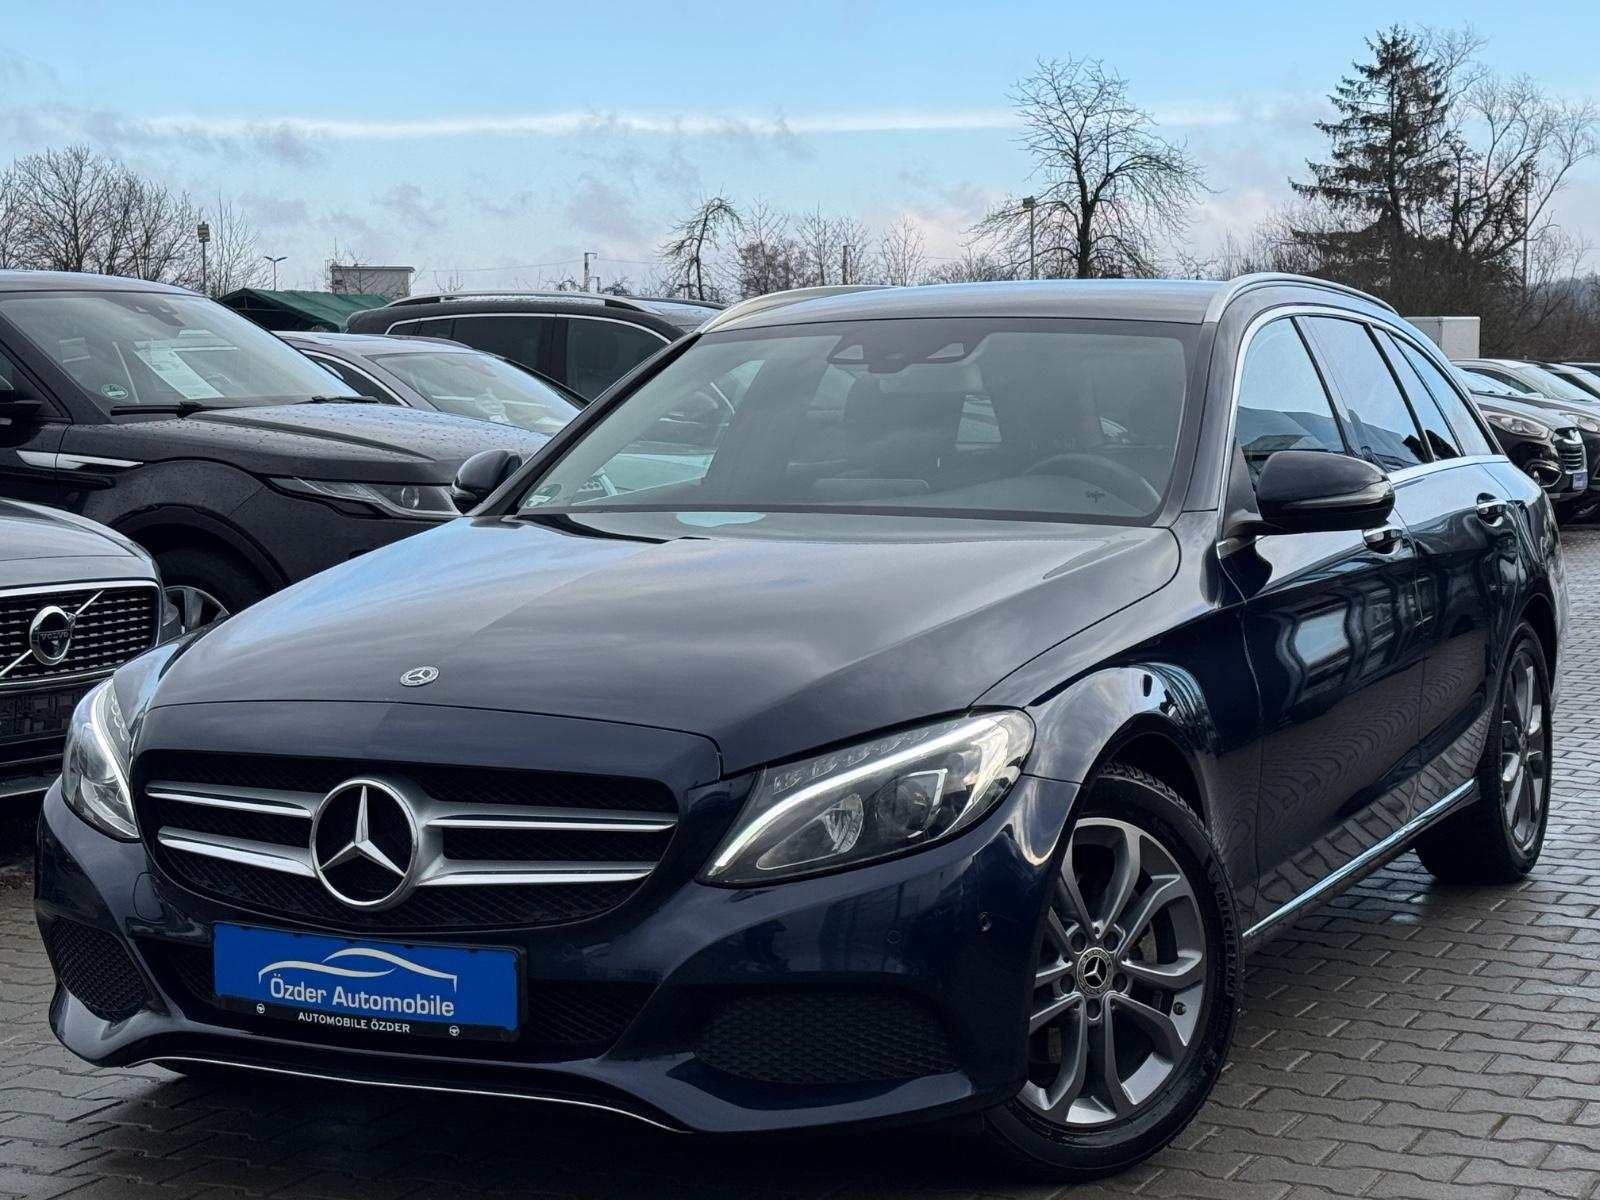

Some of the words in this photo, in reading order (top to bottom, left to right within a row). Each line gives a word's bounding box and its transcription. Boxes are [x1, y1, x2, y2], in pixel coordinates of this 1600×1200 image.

[40, 631, 69, 640] VOLVO
[1217, 892, 1236, 992] MICHELIN
[270, 973, 327, 1003] Özder
[332, 986, 455, 1016] Automobile
[298, 1011, 368, 1030] AUTOMOBILE
[370, 1018, 410, 1033] ÖZDER
